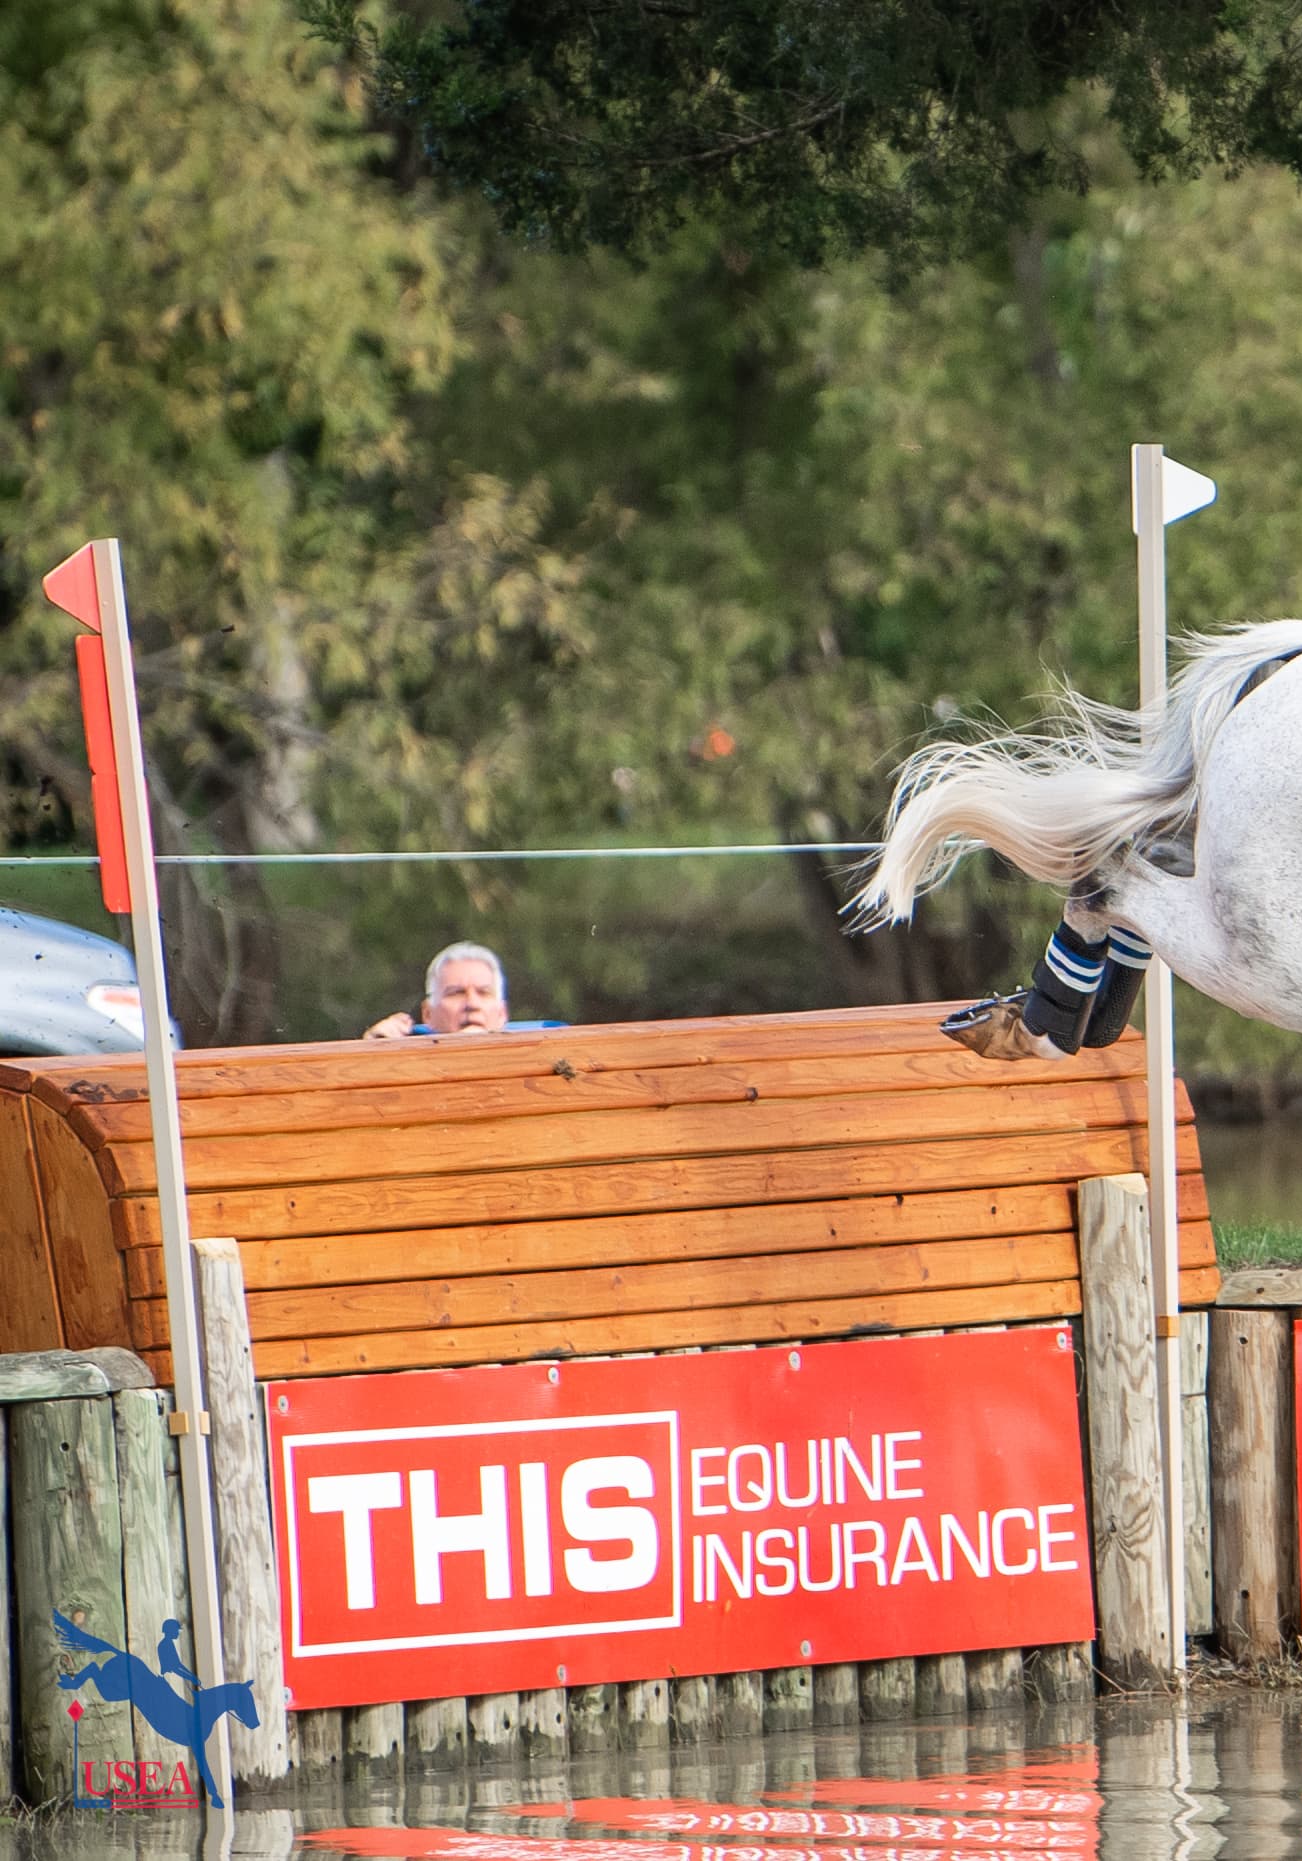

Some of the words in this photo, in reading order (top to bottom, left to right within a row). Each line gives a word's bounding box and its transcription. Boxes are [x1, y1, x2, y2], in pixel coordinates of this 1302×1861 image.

[690, 1430, 925, 1517] EQUINE
[308, 1454, 660, 1611] THIS
[692, 1503, 1079, 1604] INSURANCE
